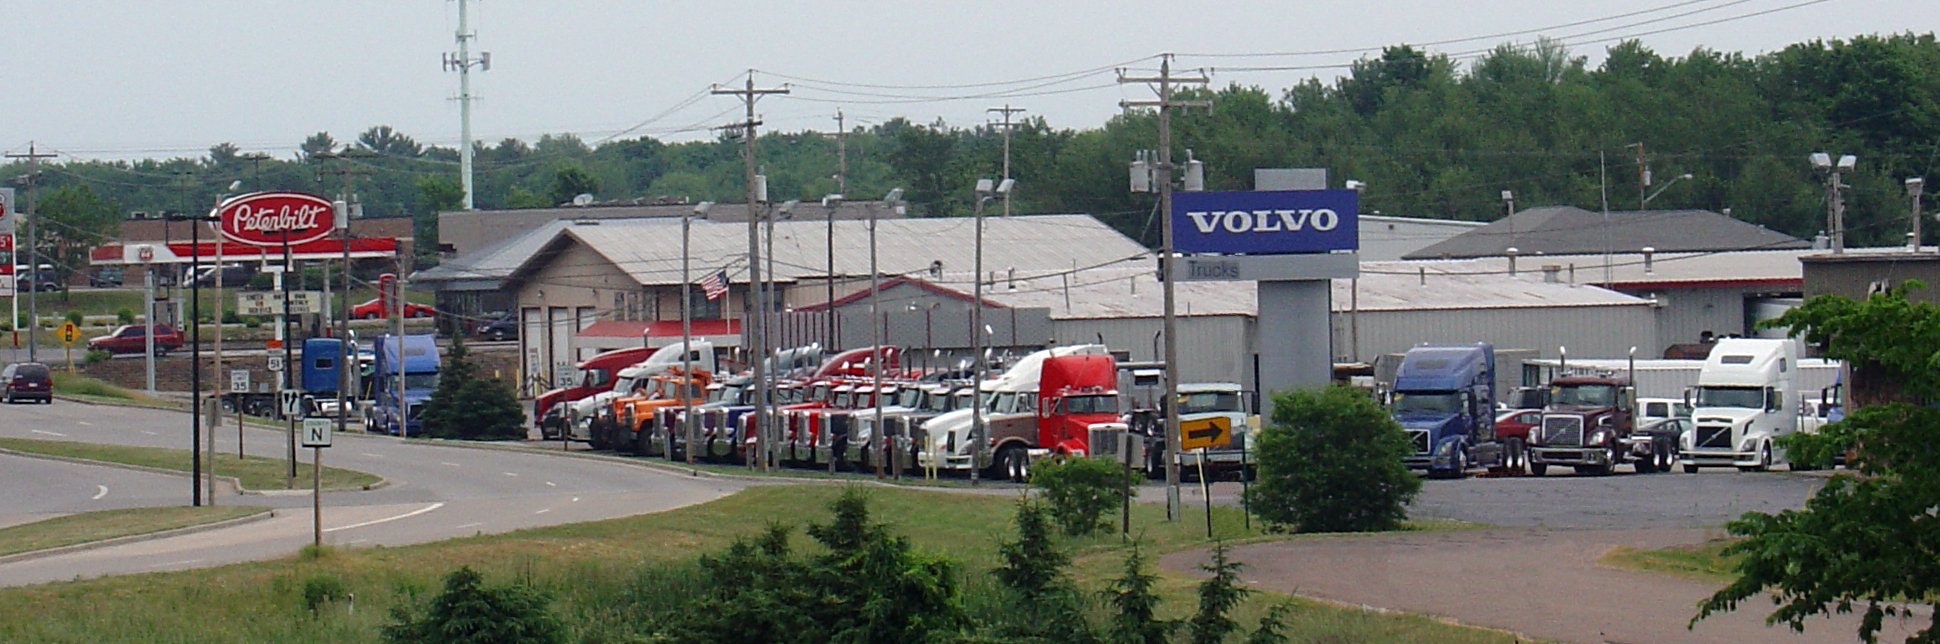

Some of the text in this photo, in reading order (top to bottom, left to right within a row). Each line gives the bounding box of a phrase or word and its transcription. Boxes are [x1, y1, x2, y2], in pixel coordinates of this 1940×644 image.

[233, 204, 327, 233] Peterbilt
[1187, 209, 1338, 233] VOLVO
[1187, 260, 1239, 278] Trucks
[233, 382, 247, 391] 35
[560, 377, 573, 386] 35
[311, 427, 323, 441] N
